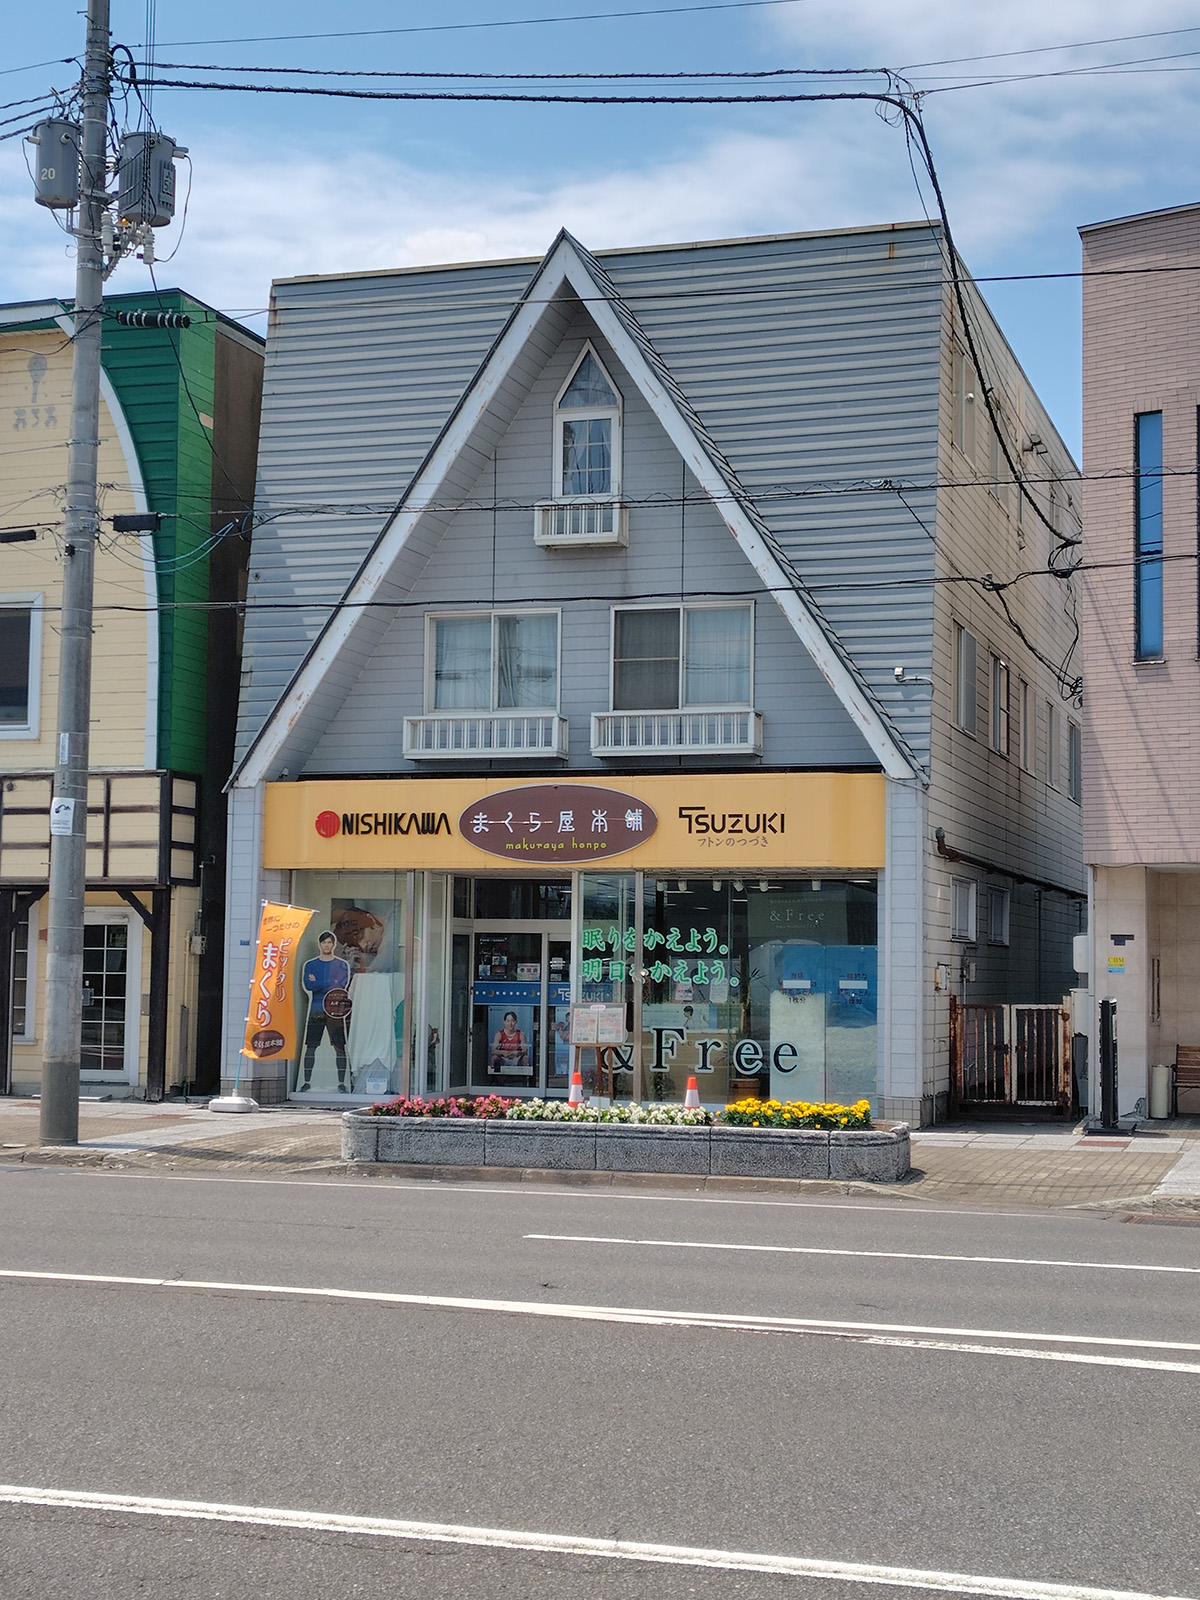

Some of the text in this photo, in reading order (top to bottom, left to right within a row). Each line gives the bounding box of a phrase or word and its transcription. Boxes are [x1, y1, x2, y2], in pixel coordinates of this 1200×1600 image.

[41, 168, 56, 180] 20
[341, 812, 452, 836] NISHIKAWA
[678, 806, 785, 834] TSUZUKI
[505, 837, 607, 851] makuraya honpo
[697, 835, 769, 848] フトンのつづき
[275, 937, 293, 1003] ピッタリ
[256, 942, 280, 1028] まくら
[650, 1026, 799, 1076] Free
